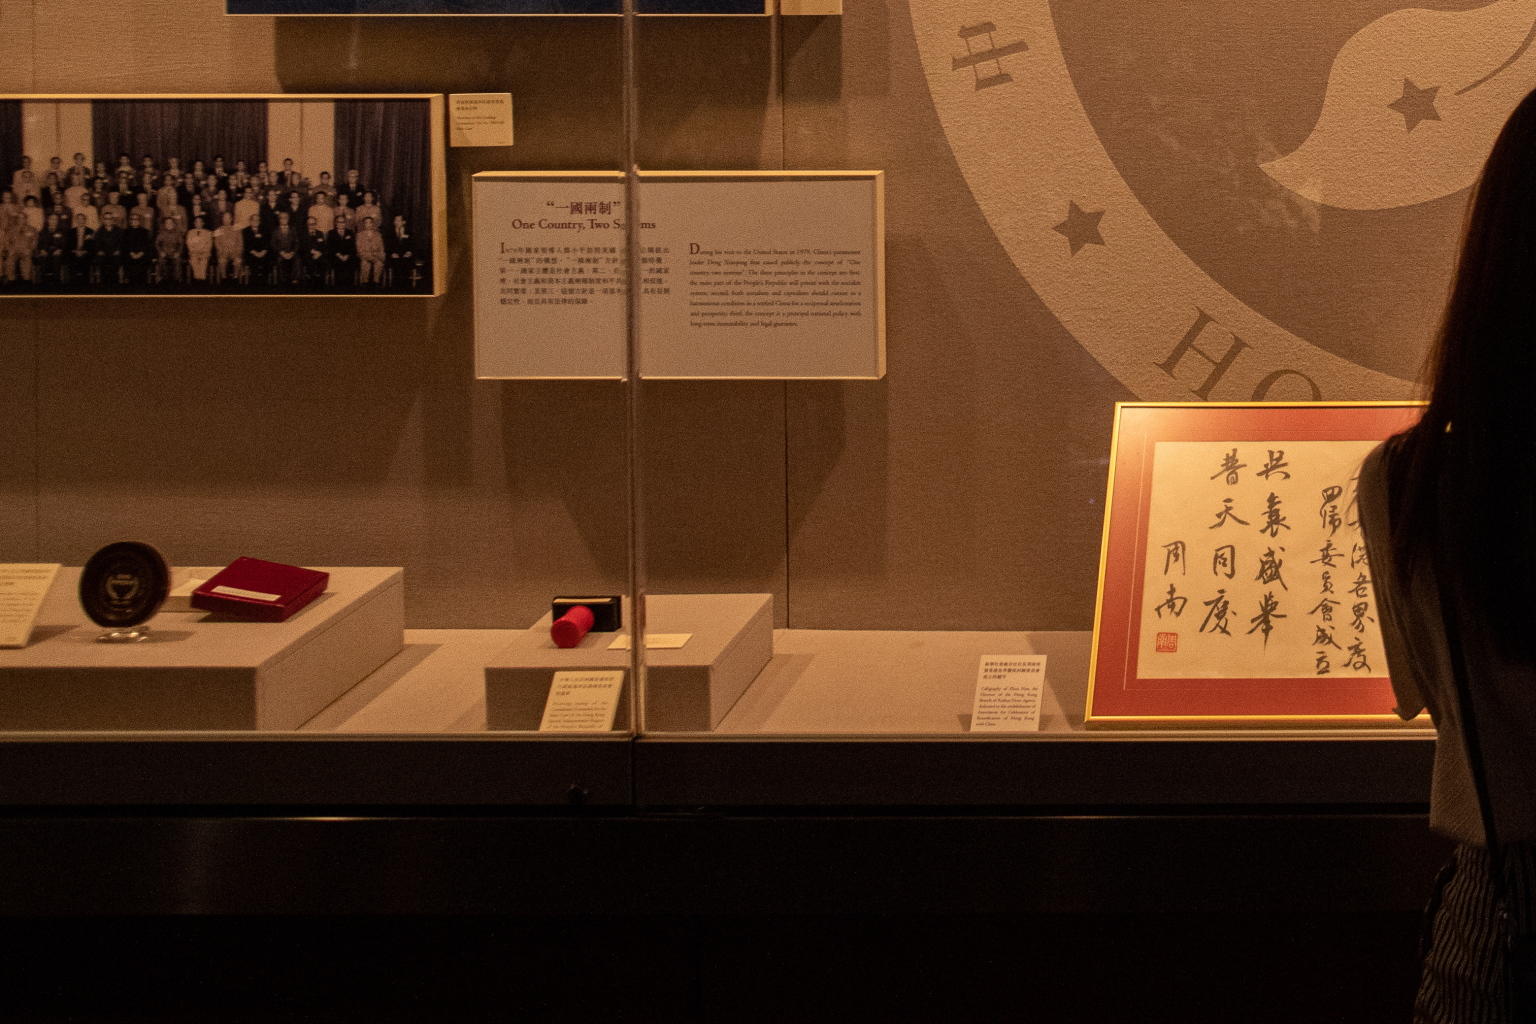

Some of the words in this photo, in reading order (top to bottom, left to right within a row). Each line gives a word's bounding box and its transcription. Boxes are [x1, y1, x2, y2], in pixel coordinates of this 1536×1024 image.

[512, 218, 535, 229] One
[538, 218, 585, 233] Country,
[587, 218, 610, 229] Two
